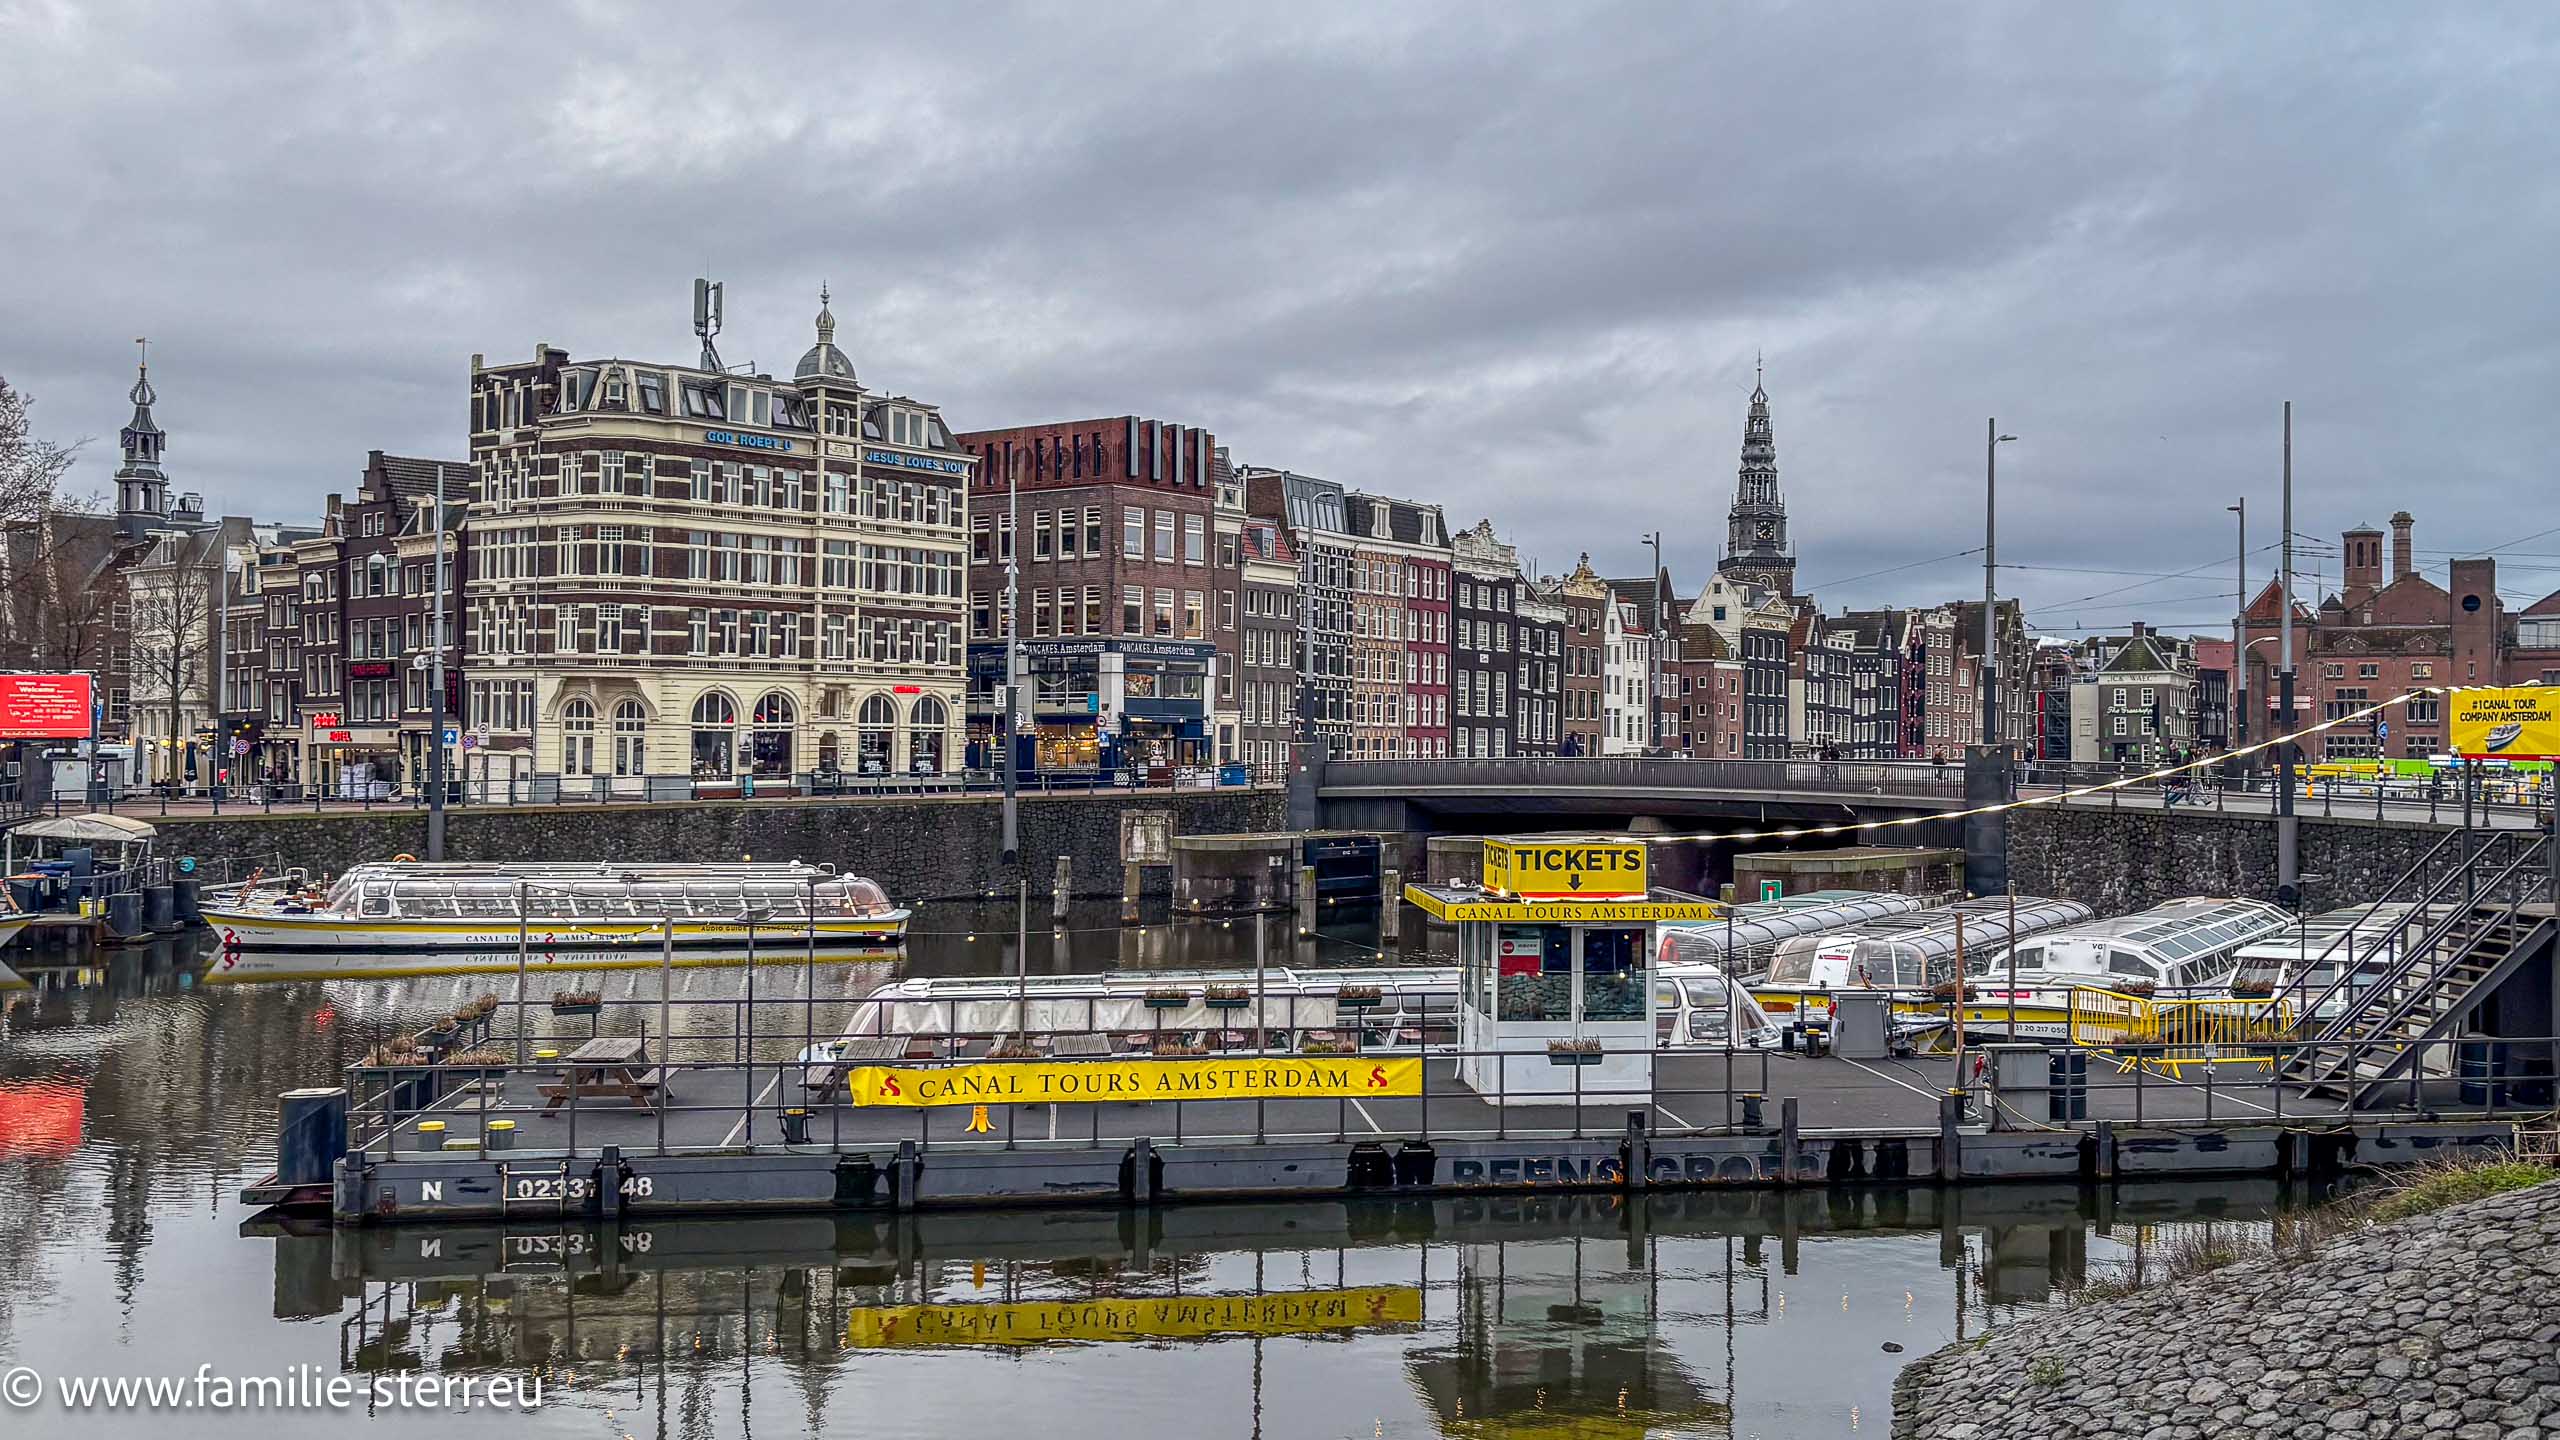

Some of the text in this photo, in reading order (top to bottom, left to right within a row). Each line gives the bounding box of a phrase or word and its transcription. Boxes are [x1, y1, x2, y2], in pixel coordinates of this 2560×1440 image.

[706, 431, 793, 450] GOD ROEPT U
[866, 451, 967, 473] JESUS LOVES YOU
[2483, 700, 2511, 709] CANAL
[2513, 699, 2536, 709] TOUR
[2459, 711, 2552, 722] COMPANY AMSTERDAM
[329, 731, 352, 742] HOTEL
[1485, 843, 1509, 869] TICKETS
[1514, 849, 1641, 872] TICKETS
[1455, 906, 1703, 919] CANAL TOURS AMSTERDAM
[465, 935, 500, 943] CANAL
[505, 935, 539, 943] TORS
[918, 1069, 1350, 1098] CANAL TOURS AMSTERDAM
[422, 1181, 442, 1201] N
